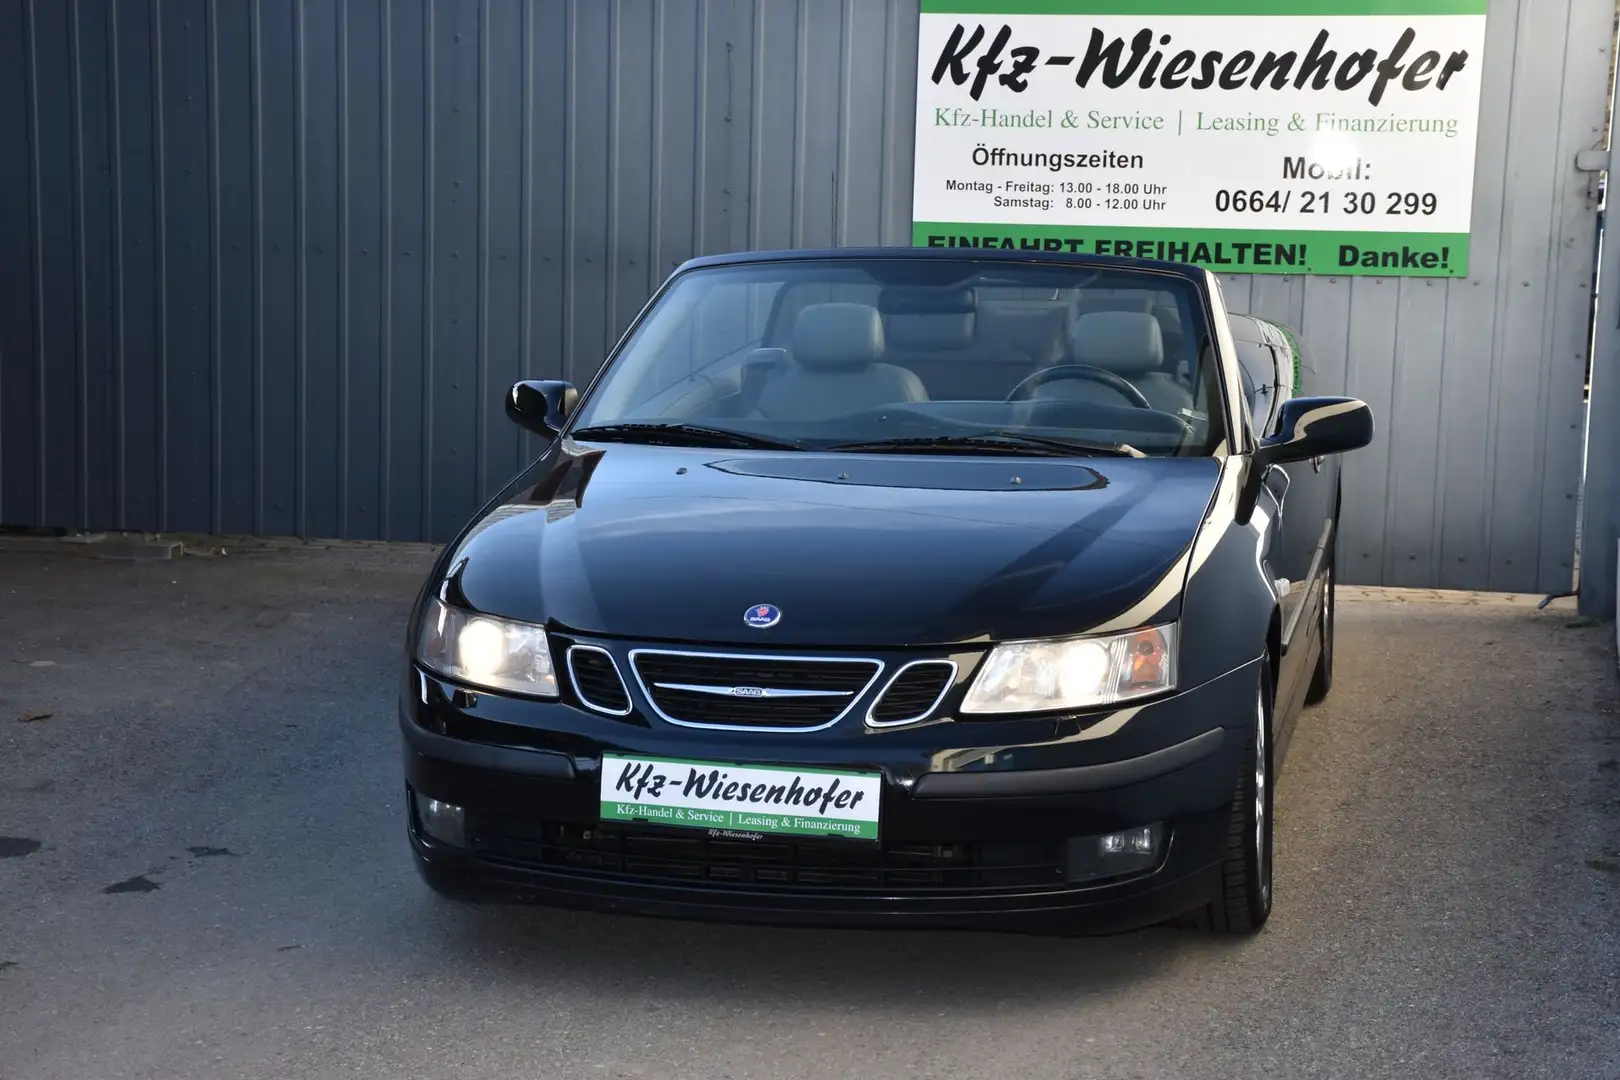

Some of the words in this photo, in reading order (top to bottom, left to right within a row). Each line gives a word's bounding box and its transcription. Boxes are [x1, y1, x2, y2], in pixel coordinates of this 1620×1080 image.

[931, 23, 1469, 107] Kfz-Wiesenhofer
[934, 107, 1053, 128] Kfz-Handel
[1060, 110, 1079, 128] &
[1086, 110, 1164, 130] Service
[1197, 112, 1280, 136] Leasing
[1287, 113, 1306, 132] &
[1316, 112, 1458, 138] Finanzierung
[972, 143, 1144, 171] Öffnungszeiten
[946, 180, 993, 193] Montag
[1005, 181, 1054, 195] Freitag:
[1059, 182, 1093, 194] 13.00
[1106, 183, 1139, 195] 18.00
[1143, 184, 1167, 195] Uhr
[1215, 189, 1291, 213] 0664/
[1300, 190, 1330, 214] 21
[1343, 191, 1376, 215] 30
[1386, 192, 1438, 216] 299
[993, 196, 1054, 211] Samstag:
[1065, 198, 1093, 209] 8.00
[1105, 198, 1139, 210] 12.00
[1142, 199, 1167, 210] Uhr
[1095, 239, 1307, 266] FREIHALTEN!
[1338, 244, 1450, 269] Danke!
[615, 762, 864, 815] Kfz-Wiesenhofer
[617, 804, 672, 818] Kfz-Handel
[675, 808, 685, 819] &
[687, 810, 724, 822] Service
[738, 814, 778, 828] Leasing
[781, 816, 791, 827] &
[794, 817, 861, 834] Finanzierung
